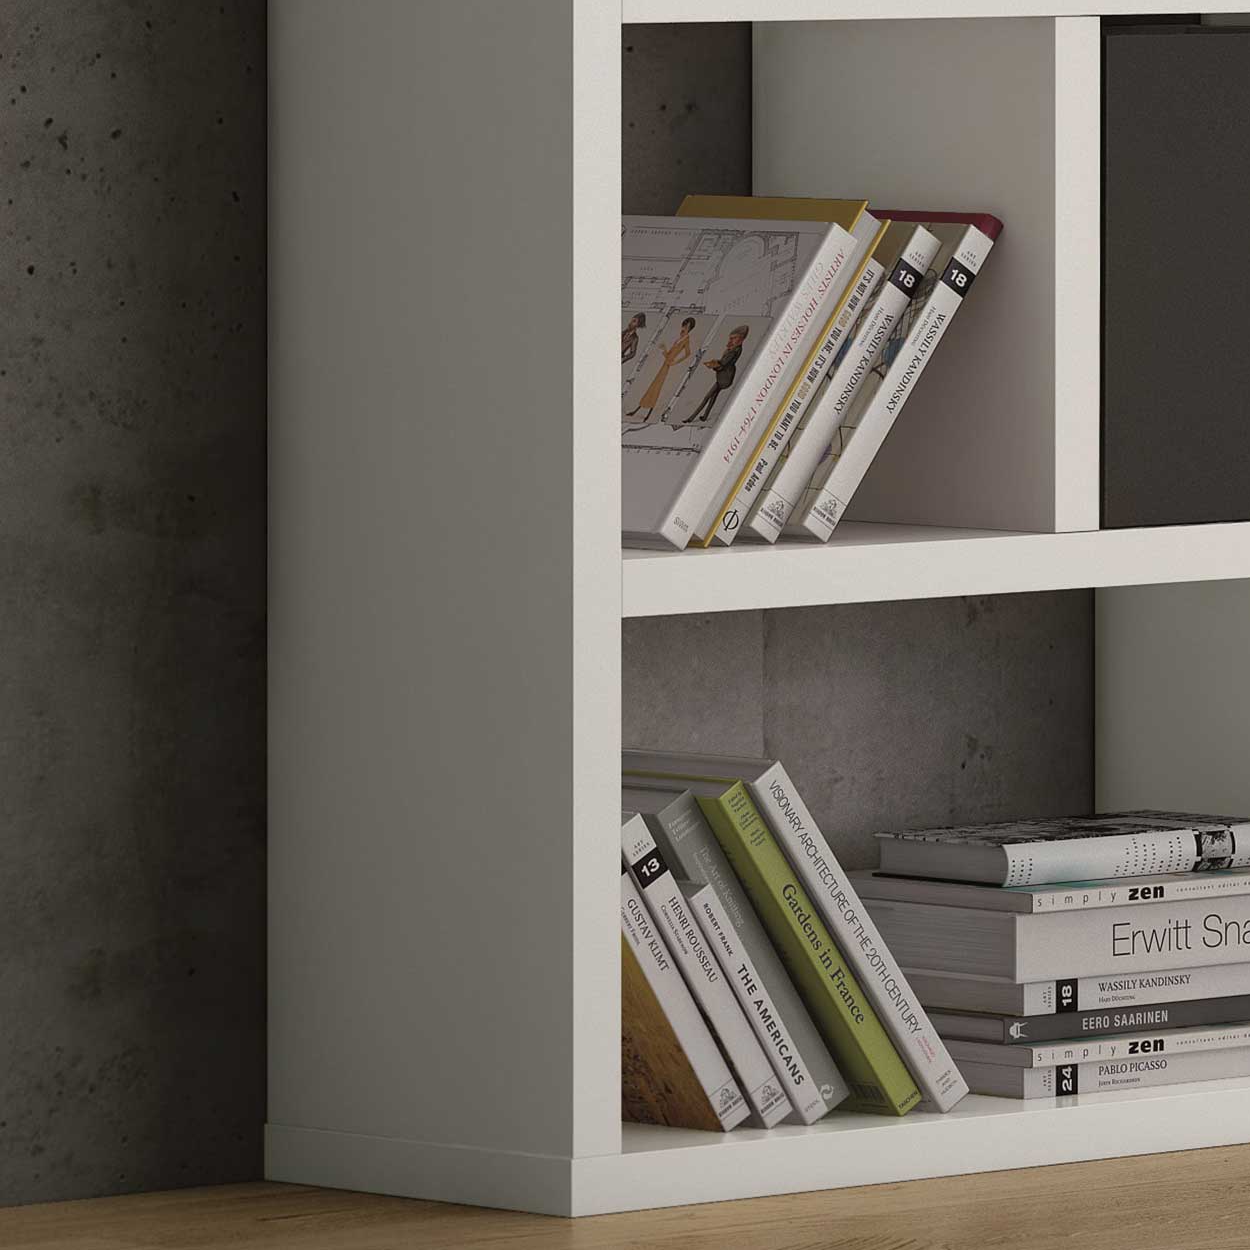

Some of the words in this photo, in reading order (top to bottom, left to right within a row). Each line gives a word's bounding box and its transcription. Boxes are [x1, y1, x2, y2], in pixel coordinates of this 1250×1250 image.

[950, 268, 968, 288] 18
[918, 313, 947, 356] WASSILY
[886, 353, 921, 414] KANDINSKY
[640, 857, 661, 878] 13
[1037, 891, 1117, 908] simply
[1128, 885, 1165, 902] zen
[627, 898, 653, 940] GUSTAV
[647, 937, 670, 972] KLIMT
[667, 895, 691, 931] HENRI
[685, 926, 719, 984] ROUSSEAU
[1112, 918, 1192, 957] Erwitt
[782, 883, 824, 951] Gardens
[819, 949, 834, 971] in
[830, 965, 866, 1026] France
[1098, 979, 1137, 992] WASSILY
[1139, 974, 1191, 989] KANDINSKY
[1082, 1014, 1110, 1031] EERO
[1114, 1010, 1169, 1028] SAARINEN
[1061, 1065, 1073, 1092] 24
[1098, 1064, 1127, 1077] PABLO
[1129, 1059, 1167, 1073] PICASSO
